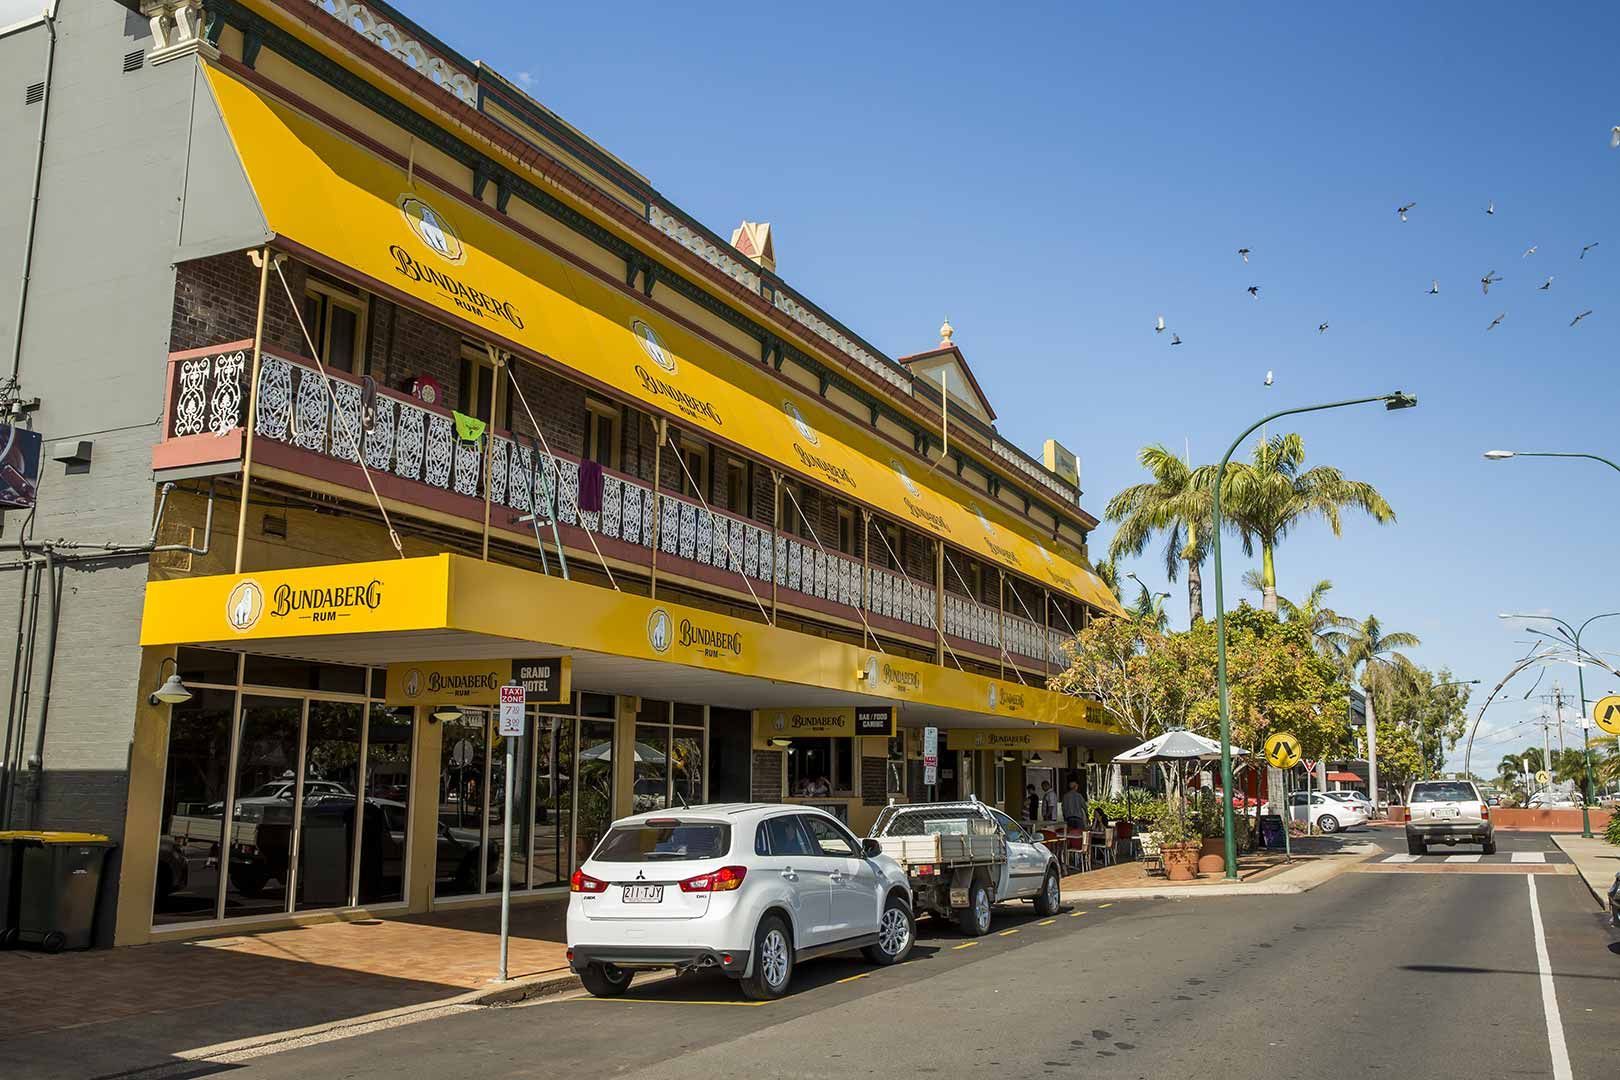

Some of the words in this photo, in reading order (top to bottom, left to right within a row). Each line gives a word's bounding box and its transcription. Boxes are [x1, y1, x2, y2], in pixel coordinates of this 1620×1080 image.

[389, 244, 524, 330] BUNDABERG
[454, 297, 484, 318] RUM
[270, 580, 384, 617] BUNDABERG
[312, 611, 337, 622] RUM
[679, 618, 742, 655] BUNDABERG
[704, 648, 718, 658] RUM
[520, 666, 550, 679] GRAND
[522, 680, 548, 692] HOTEL
